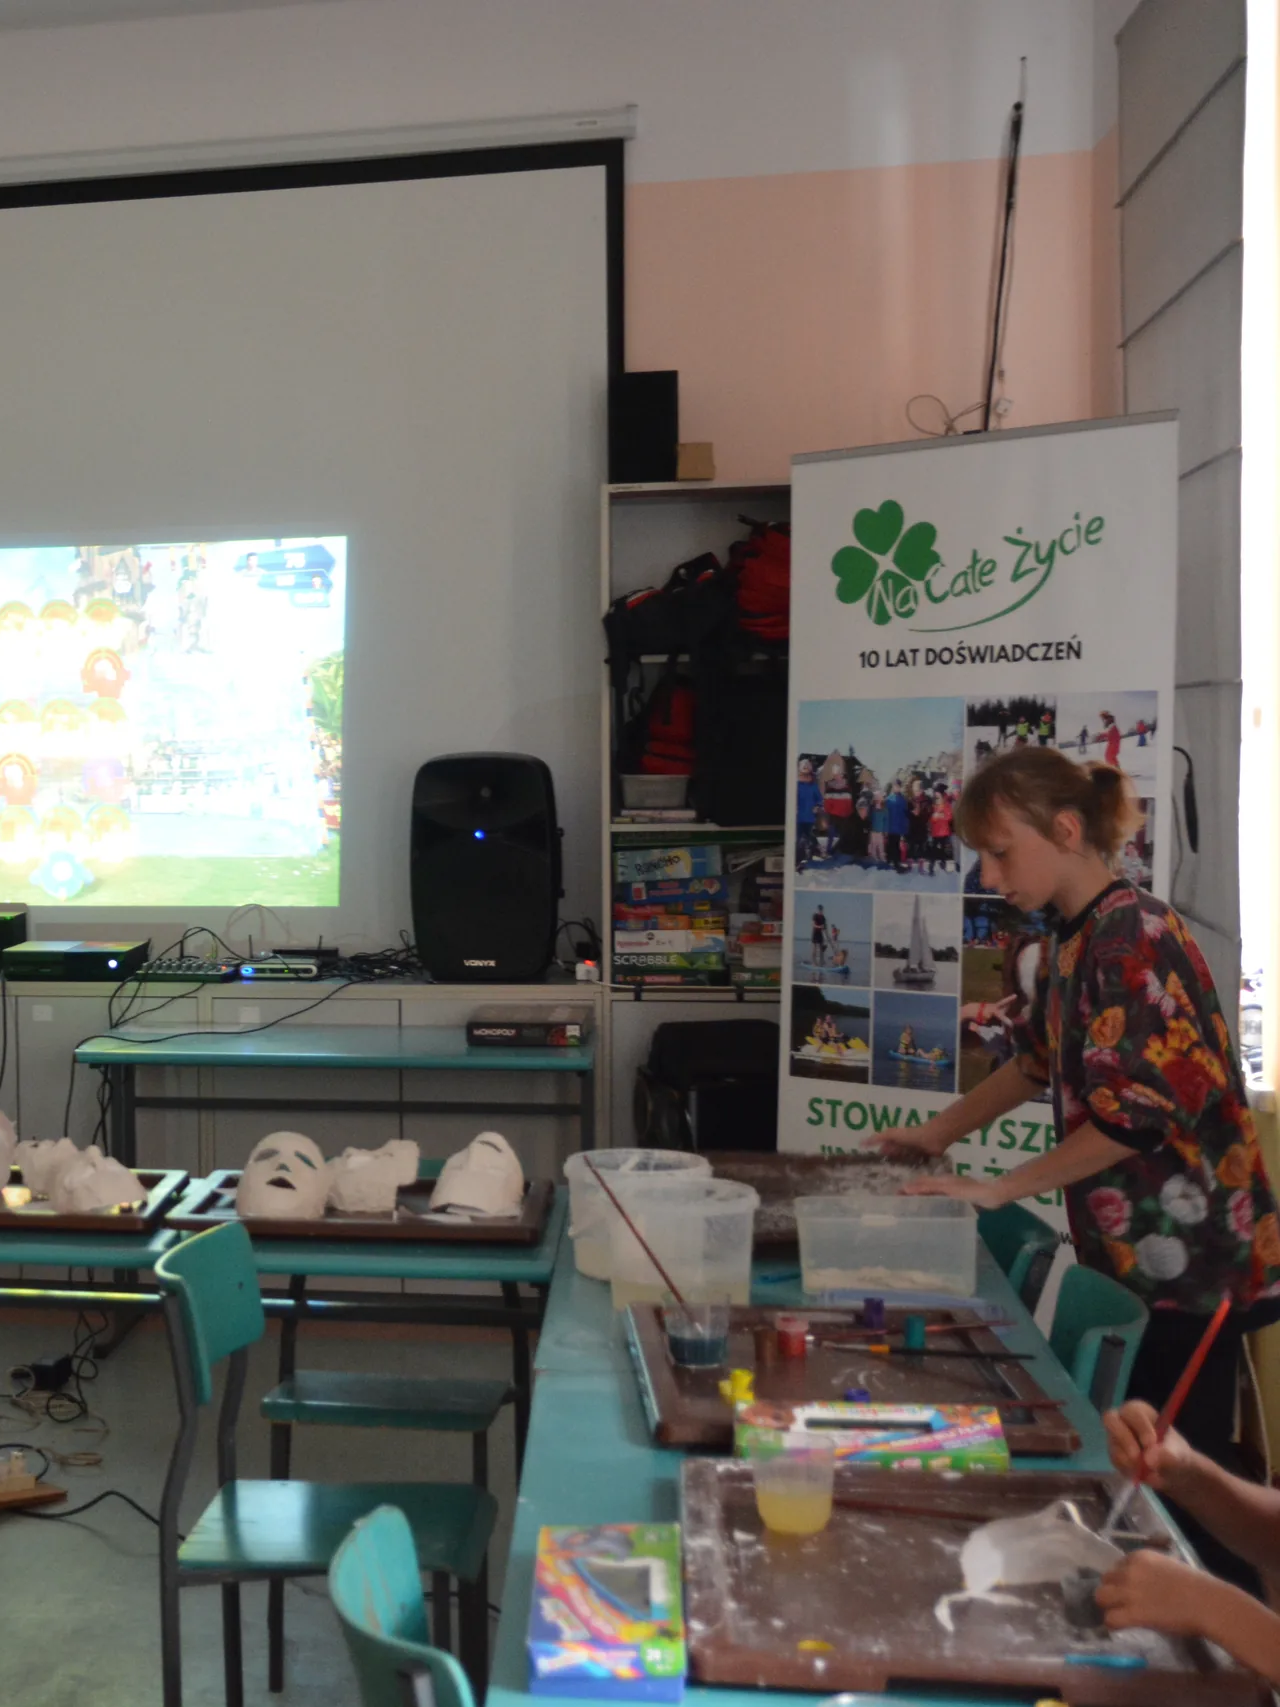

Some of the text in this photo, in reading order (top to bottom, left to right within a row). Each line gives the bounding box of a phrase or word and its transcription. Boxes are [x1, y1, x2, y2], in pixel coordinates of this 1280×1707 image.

[871, 576, 919, 625] Na
[1003, 512, 1105, 584] Życie
[859, 634, 1082, 669] 10 LAT DOŚWIADCZEŃ
[463, 959, 497, 967] VONYX
[613, 953, 679, 967] SCRABBLE
[472, 1027, 517, 1037] MONOPOLY
